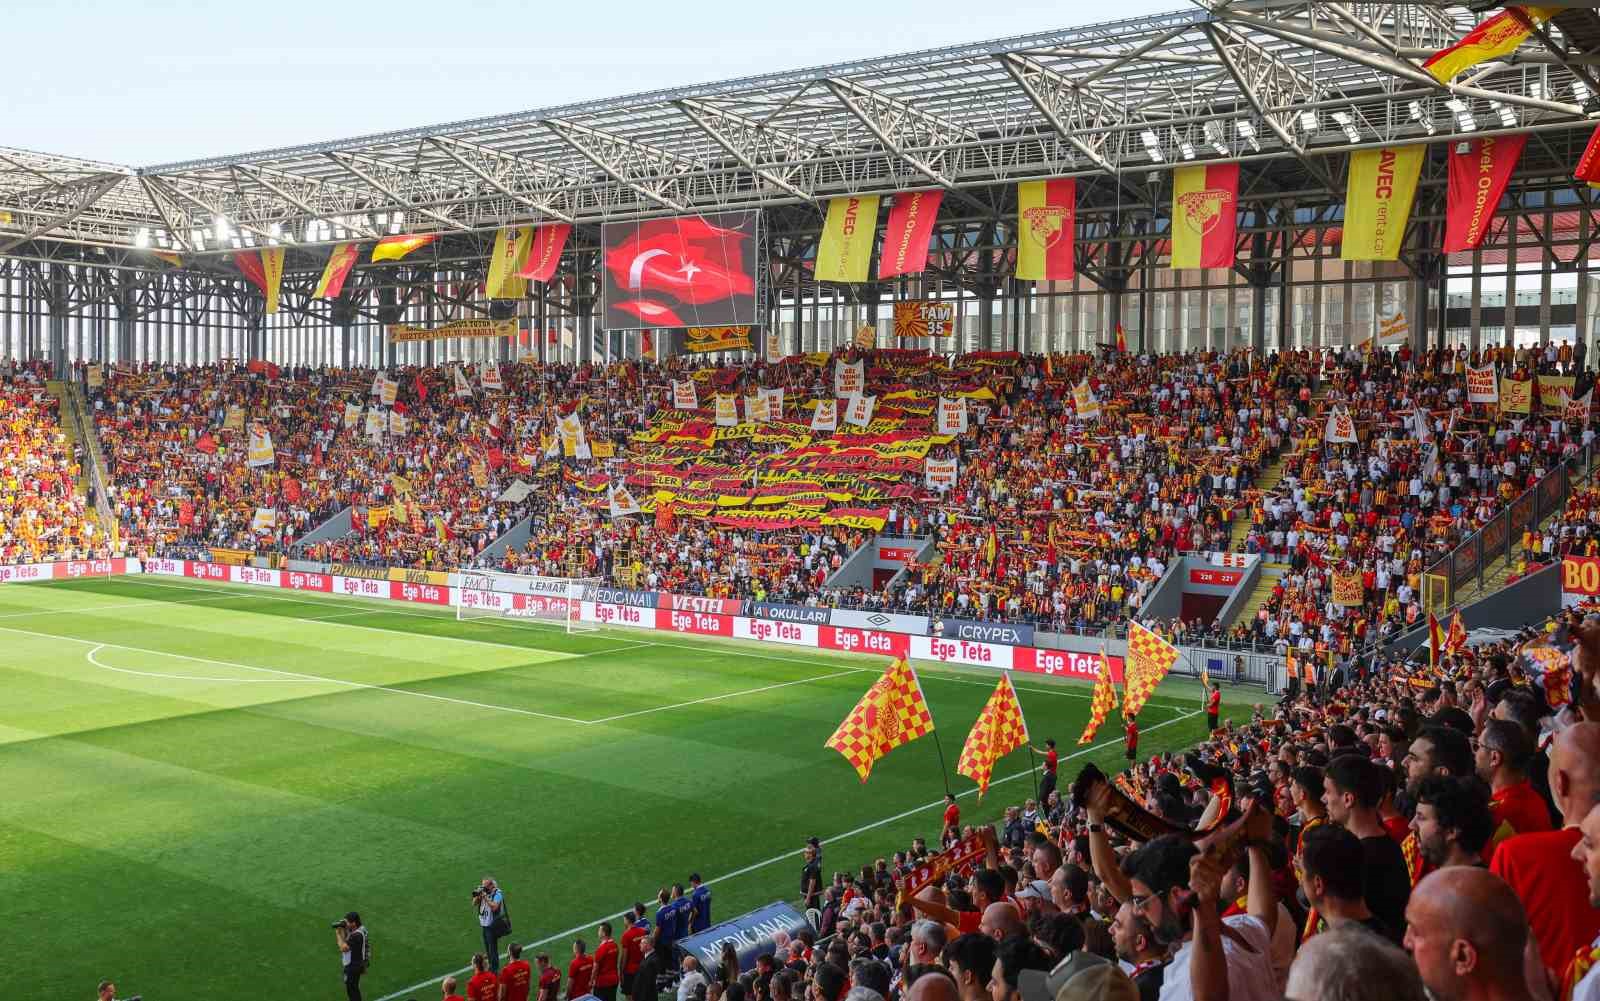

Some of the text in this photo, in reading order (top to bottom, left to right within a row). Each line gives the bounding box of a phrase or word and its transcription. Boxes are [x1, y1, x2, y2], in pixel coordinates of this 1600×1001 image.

[1480, 137, 1496, 173] Avek
[1375, 148, 1395, 199] AVEC
[842, 199, 860, 236] AVEC
[920, 306, 951, 320] TAM
[928, 321, 944, 334] 35
[0, 567, 10, 580] ge
[193, 563, 223, 578] Ege Teta
[240, 567, 271, 583] Ege Teta
[290, 573, 322, 589] Ege Teta
[344, 578, 378, 594] Ege Teta
[403, 584, 439, 601] Ege Teta
[595, 605, 640, 623] Ege Teta
[672, 611, 720, 632] Ege Teta
[770, 607, 828, 623] OKULLARI
[750, 619, 802, 641] Ege Teta
[958, 624, 1021, 644] ICRYPEX
[835, 629, 891, 650] Ege Teta
[931, 638, 991, 662] Ege Teta
[1036, 650, 1063, 674] Ege
